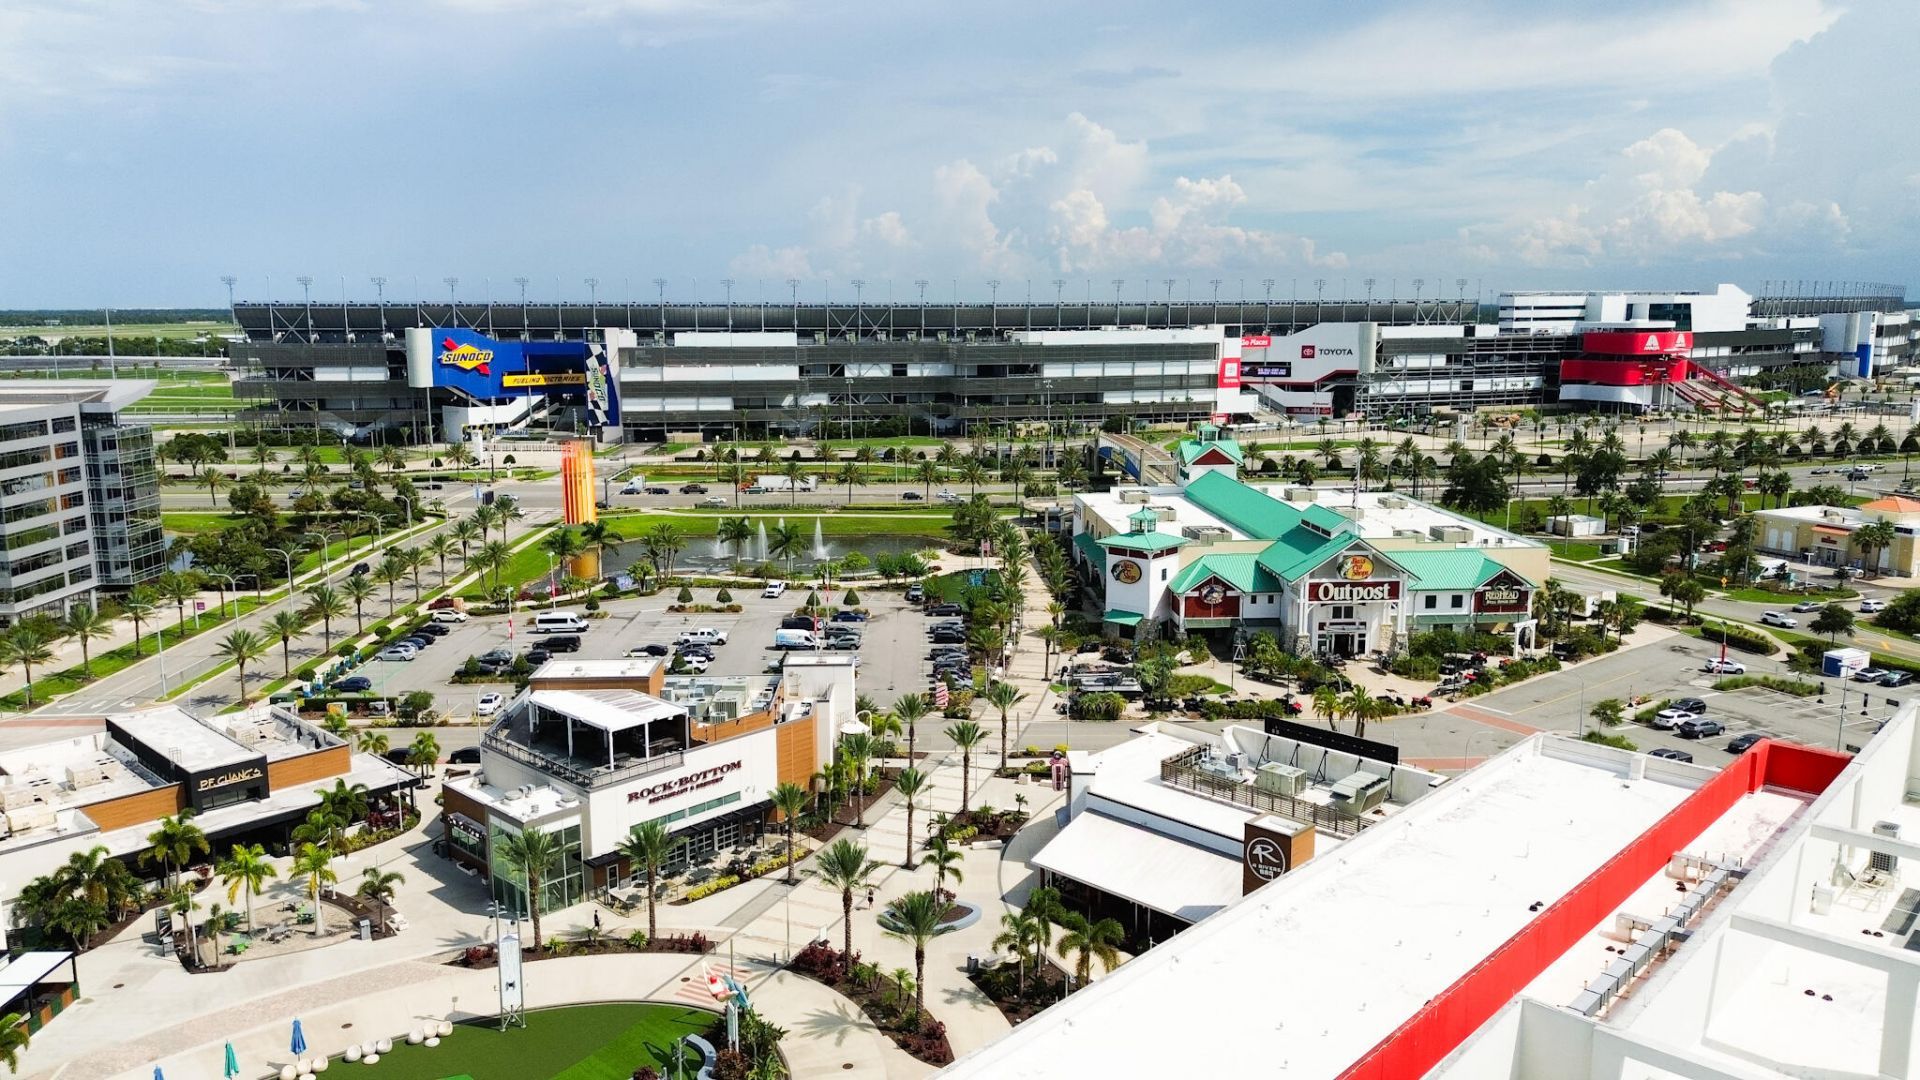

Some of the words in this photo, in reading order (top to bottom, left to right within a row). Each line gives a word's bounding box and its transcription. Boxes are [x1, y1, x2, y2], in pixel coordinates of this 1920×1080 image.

[1319, 348, 1353, 356] TOYOTA
[445, 352, 491, 362] SUNOCO
[544, 375, 582, 384] VICTORIES
[591, 367, 606, 402] SUNOCO
[1352, 557, 1366, 565] Bass
[1318, 583, 1391, 604] Outpost
[627, 781, 674, 803] ROCK
[678, 760, 742, 788] BOTTOM
[1258, 864, 1281, 872] RIVERS
